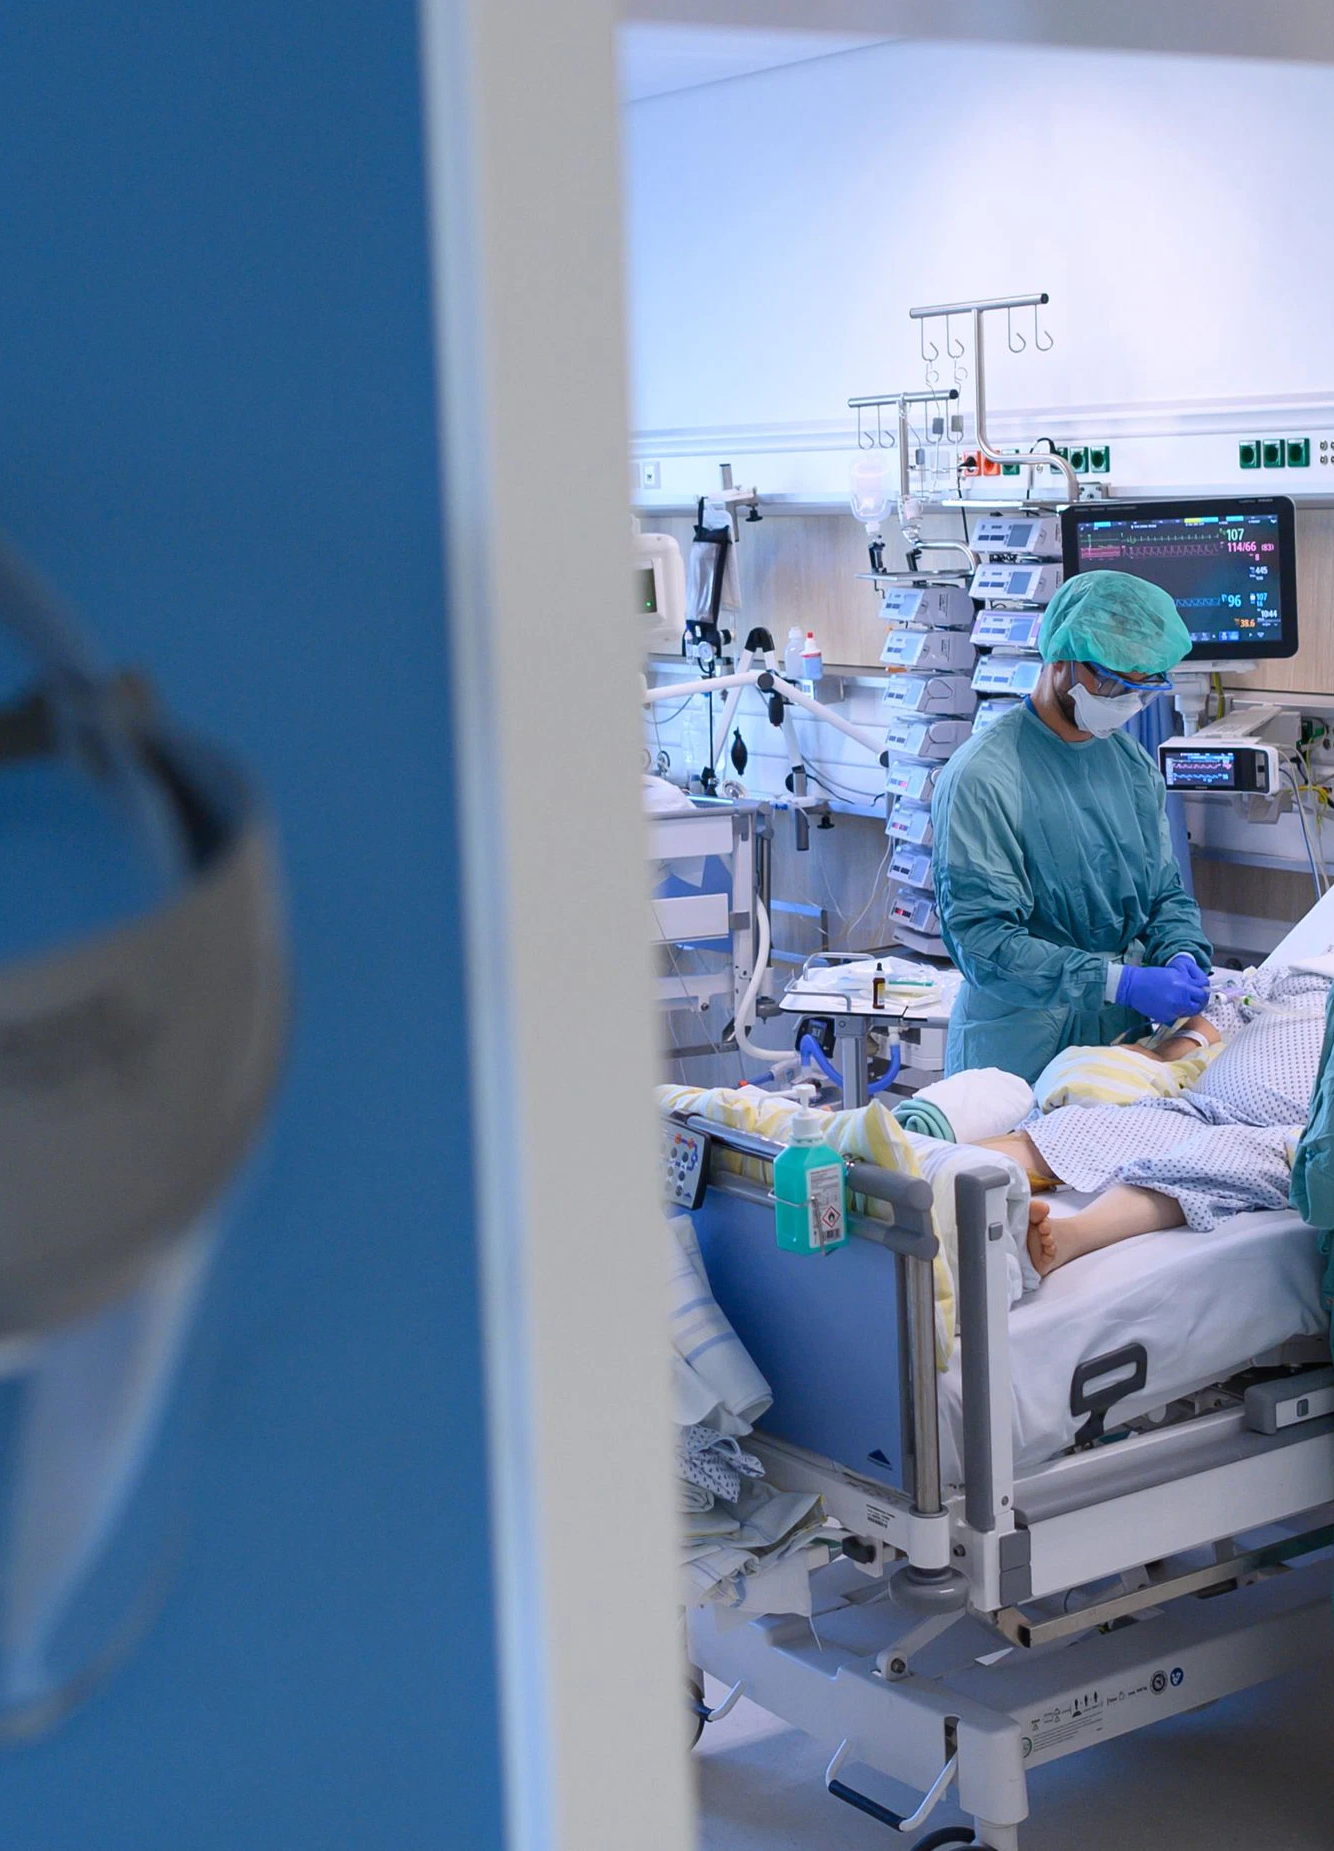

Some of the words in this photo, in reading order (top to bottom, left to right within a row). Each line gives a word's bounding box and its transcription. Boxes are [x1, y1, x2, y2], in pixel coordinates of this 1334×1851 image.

[1227, 528, 1244, 541] 107
[1227, 541, 1257, 552] 114/66
[1227, 594, 1242, 607] 96
